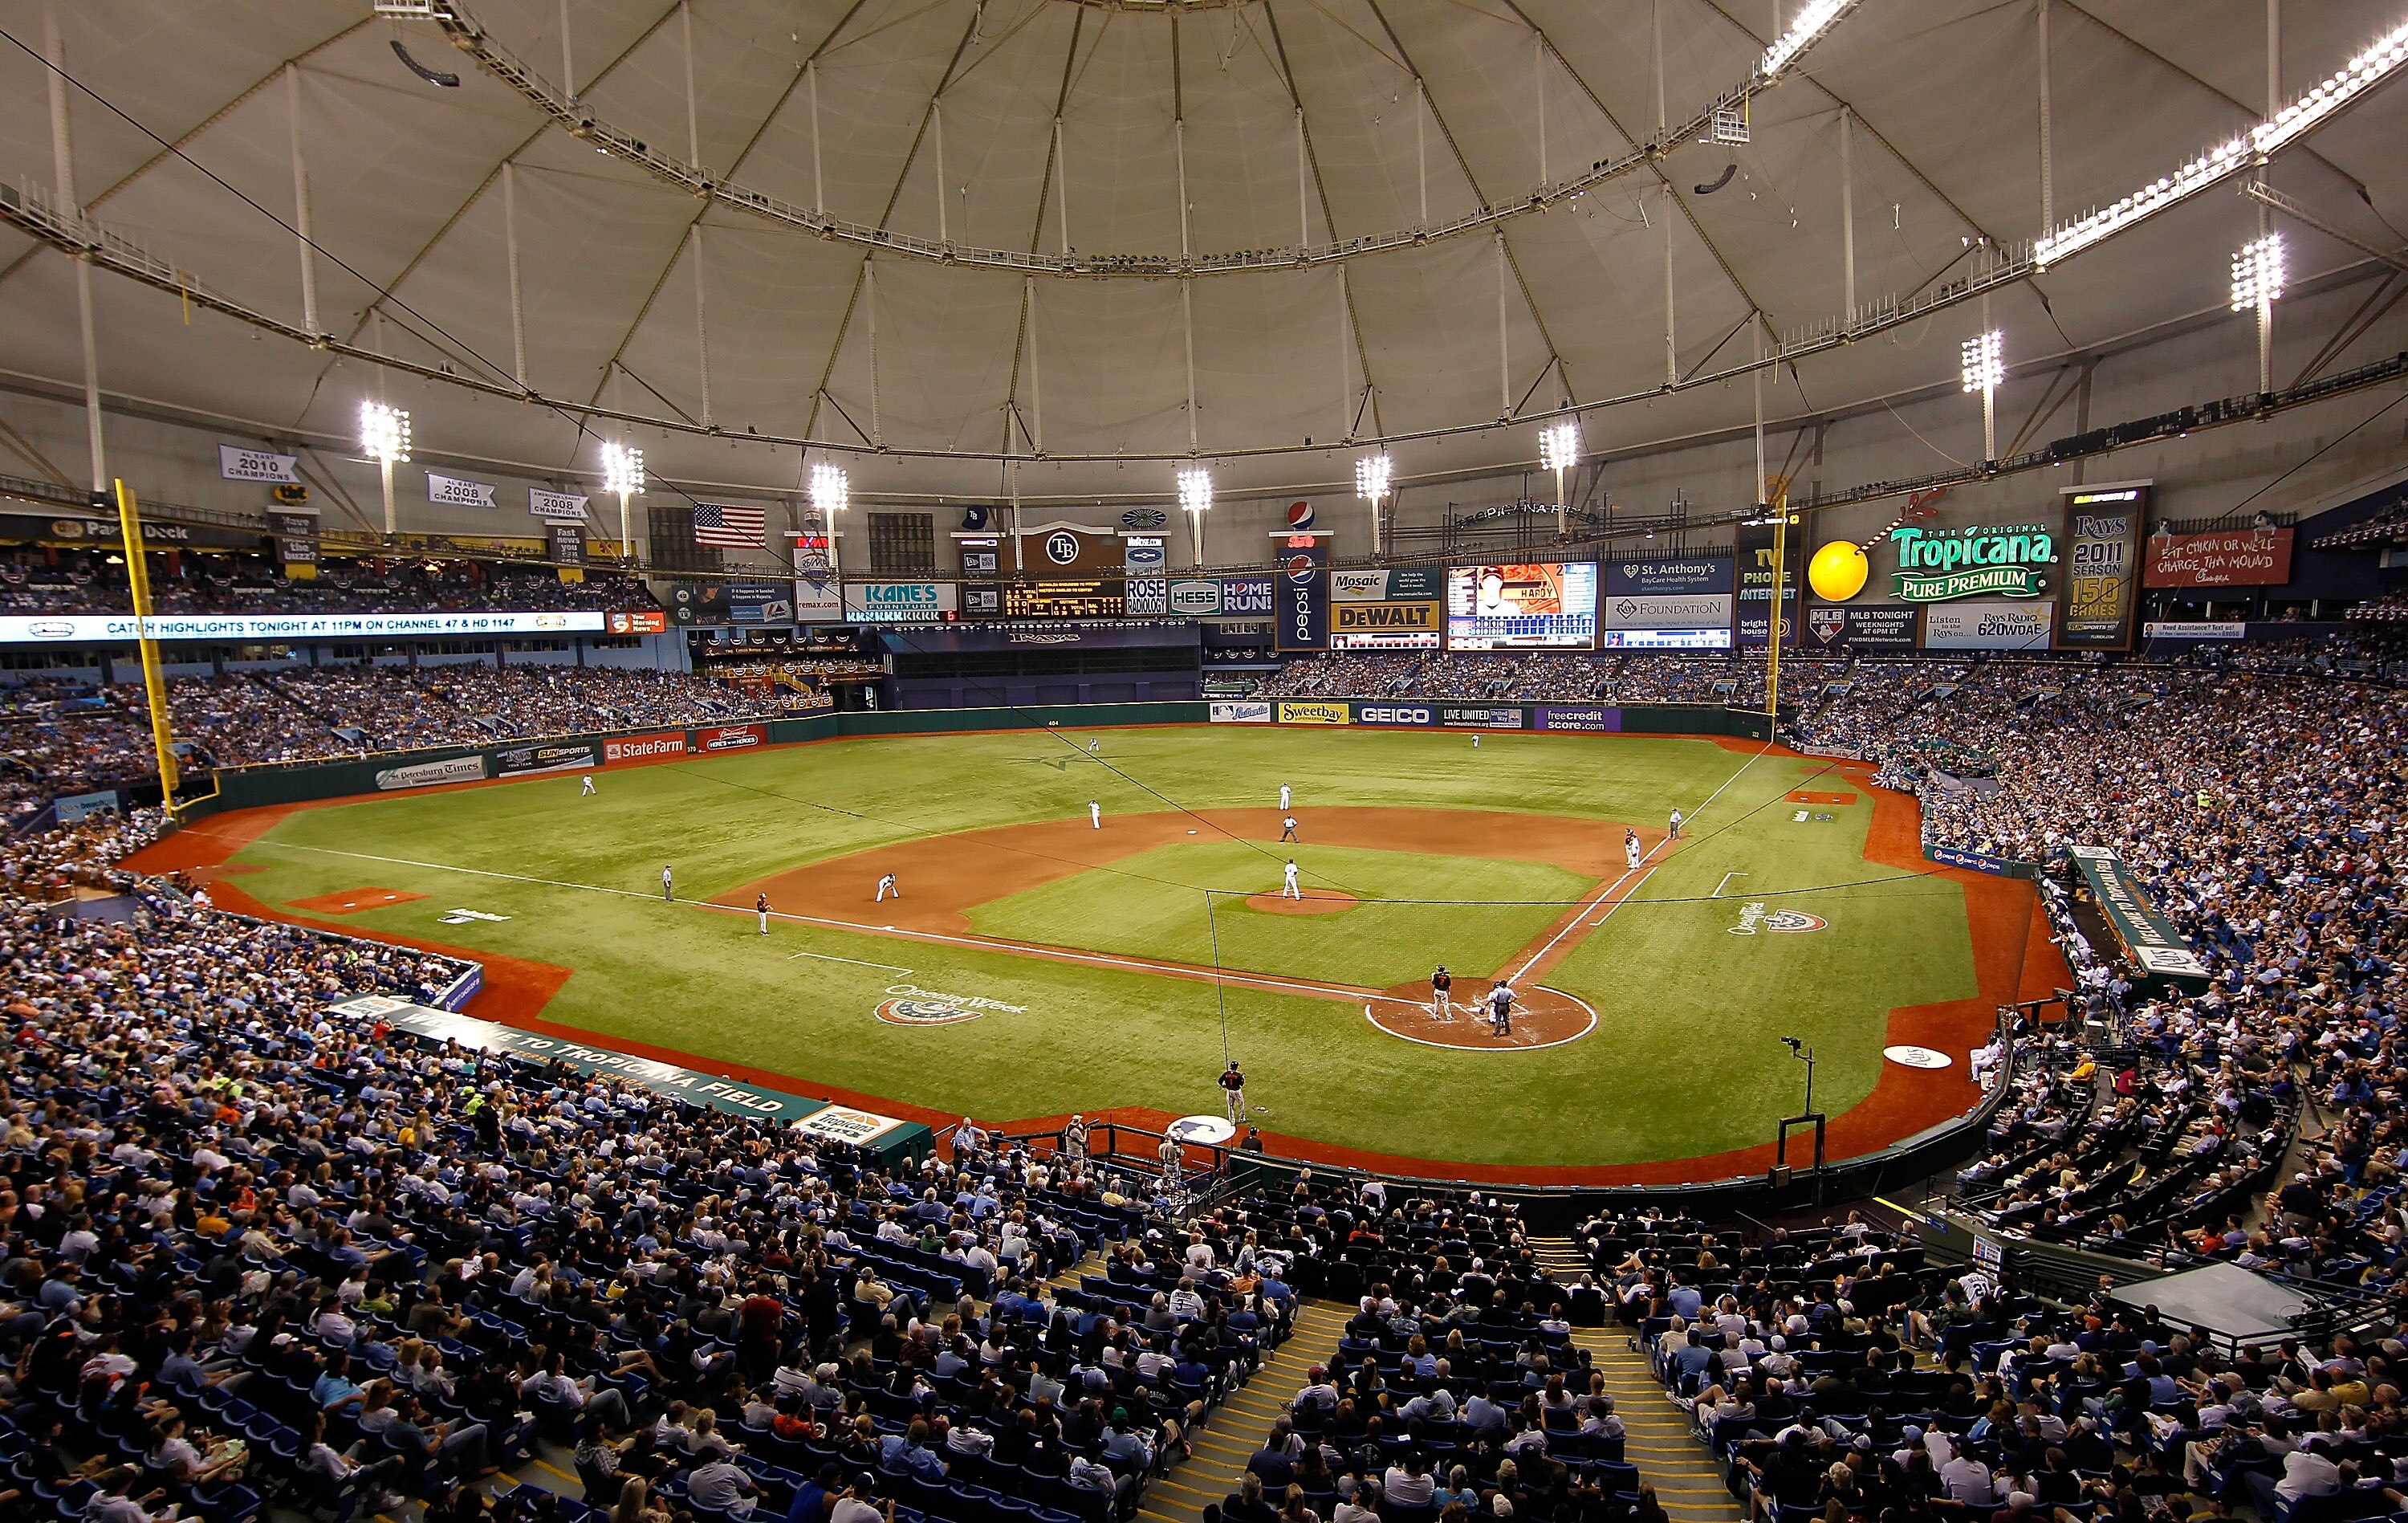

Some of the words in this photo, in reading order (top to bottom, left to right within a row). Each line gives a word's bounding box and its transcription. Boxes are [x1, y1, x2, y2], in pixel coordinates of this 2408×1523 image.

[239, 458, 279, 472] 2010
[228, 468, 290, 480] CHAMPIONS
[445, 485, 478, 499] 2008
[434, 493, 488, 506] CHAMPIONS
[543, 499, 574, 510] 2008
[535, 506, 582, 516] CHAMPIONS
[557, 528, 576, 537] Fast
[1928, 529, 1956, 538] THE
[1983, 524, 2046, 535] ORIGINAL
[289, 543, 309, 552] the
[1052, 538, 1075, 558] TB
[1890, 527, 2052, 572] Tropicana
[2074, 541, 2125, 565] 2011
[2162, 547, 2184, 559] EAT
[2186, 539, 2220, 555] CHIKIN
[2223, 539, 2239, 552] OR
[283, 551, 317, 560] buzz?
[1755, 548, 1780, 567] TV
[1556, 564, 1564, 576] 2
[1641, 565, 1657, 575] St.
[1659, 563, 1715, 576] Anthony's
[2073, 564, 2121, 576] SEASON
[2158, 560, 2200, 573] CHARGE
[2204, 556, 2226, 569] THA
[2229, 555, 2273, 569] MOUND
[1335, 574, 1381, 587] Mosaic
[1902, 581, 1945, 597] PURE
[1947, 571, 2027, 595] PREMIUM
[865, 585, 938, 602] KANE'S
[1127, 580, 1165, 598] ROSE
[1521, 588, 1553, 598] HARDY
[2072, 577, 2120, 604] 150
[1173, 591, 1216, 604] HESS
[1224, 596, 1272, 611] RUN!
[1128, 598, 1165, 613] RADIOLOGY
[1640, 601, 1722, 615] FOUNDATION
[2070, 604, 2117, 617] GAMES
[1293, 588, 1312, 641] pepsi
[1812, 611, 1843, 621] MLB
[1850, 612, 1870, 620] MLB
[1872, 611, 1914, 620] TONIGHT
[1929, 616, 1961, 624] Listen
[160, 621, 244, 633] HIGHLIGHTS
[250, 621, 308, 631] TONIGHT
[311, 621, 327, 630] AT
[332, 621, 362, 630] 11PM
[366, 620, 383, 630] ON
[387, 619, 441, 629] CHANNEL
[445, 619, 458, 628] 47
[461, 618, 469, 628] &
[472, 618, 488, 628] HD
[493, 618, 515, 628] 1147
[612, 621, 629, 633] 9
[1741, 620, 1767, 628] bright
[1741, 627, 1767, 635] house
[1283, 703, 1343, 722] Sweetbay
[1361, 707, 1430, 723] GEICO
[1443, 709, 1461, 719] LIVE
[1462, 710, 1490, 720] UNITED
[1547, 710, 1603, 721] freecredit
[1547, 720, 1605, 730] score.com
[401, 768, 443, 781] Petersburg
[444, 762, 479, 774] Times
[1964, 857, 1978, 865] pepsi
[2121, 910, 2169, 945] WELCOME
[885, 983, 968, 1004] Opening
[967, 996, 1030, 1014] Week
[517, 1036, 555, 1050] TO
[553, 1043, 699, 1089] TROPICANA
[695, 1081, 784, 1113] FIELD
[817, 1113, 875, 1133] Tropicana
[1973, 1282, 1988, 1297] 21
